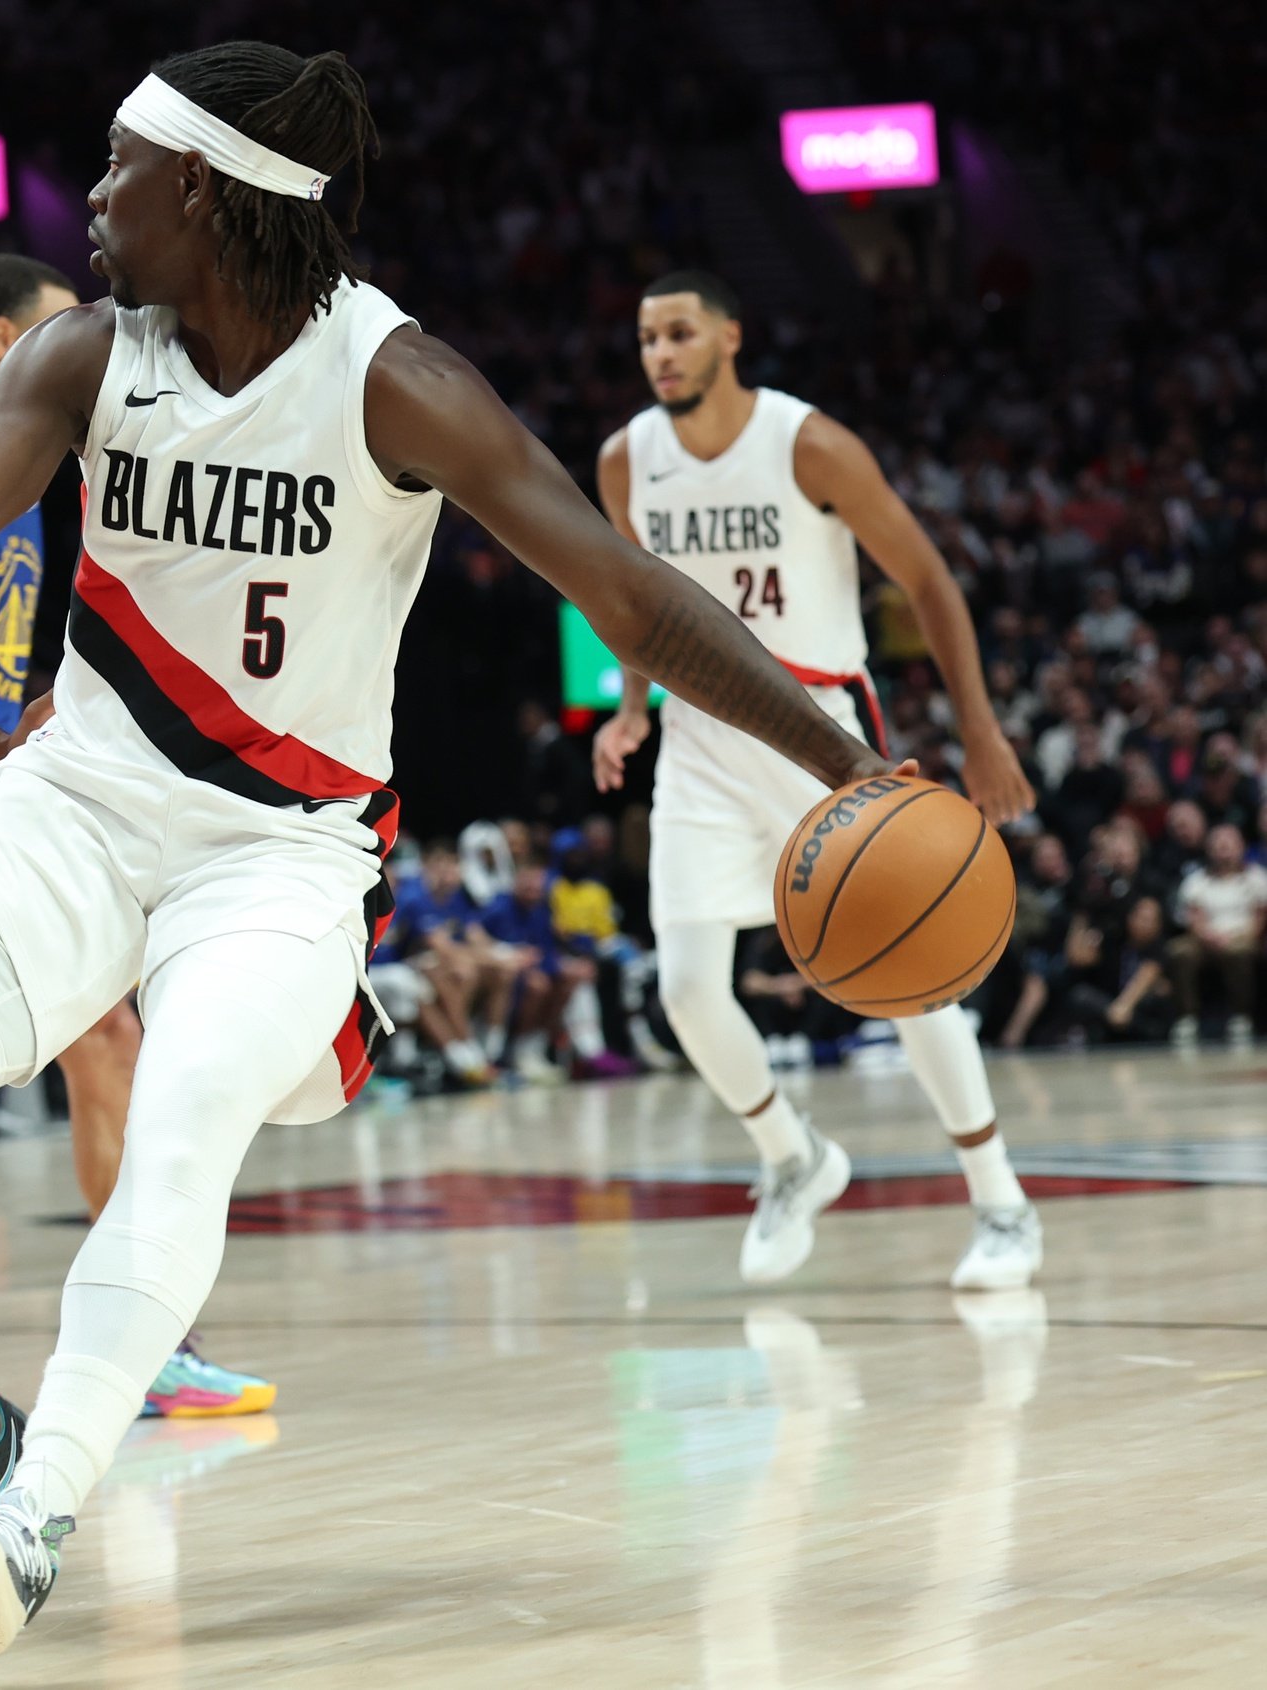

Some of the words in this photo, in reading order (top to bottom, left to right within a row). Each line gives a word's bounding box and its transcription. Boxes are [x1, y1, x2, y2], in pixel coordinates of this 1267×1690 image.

[102, 447, 336, 557] BLAZERS
[646, 504, 781, 556] BLAZERS
[241, 581, 290, 680] 5
[734, 562, 787, 619] 24
[790, 777, 910, 894] Wilson
